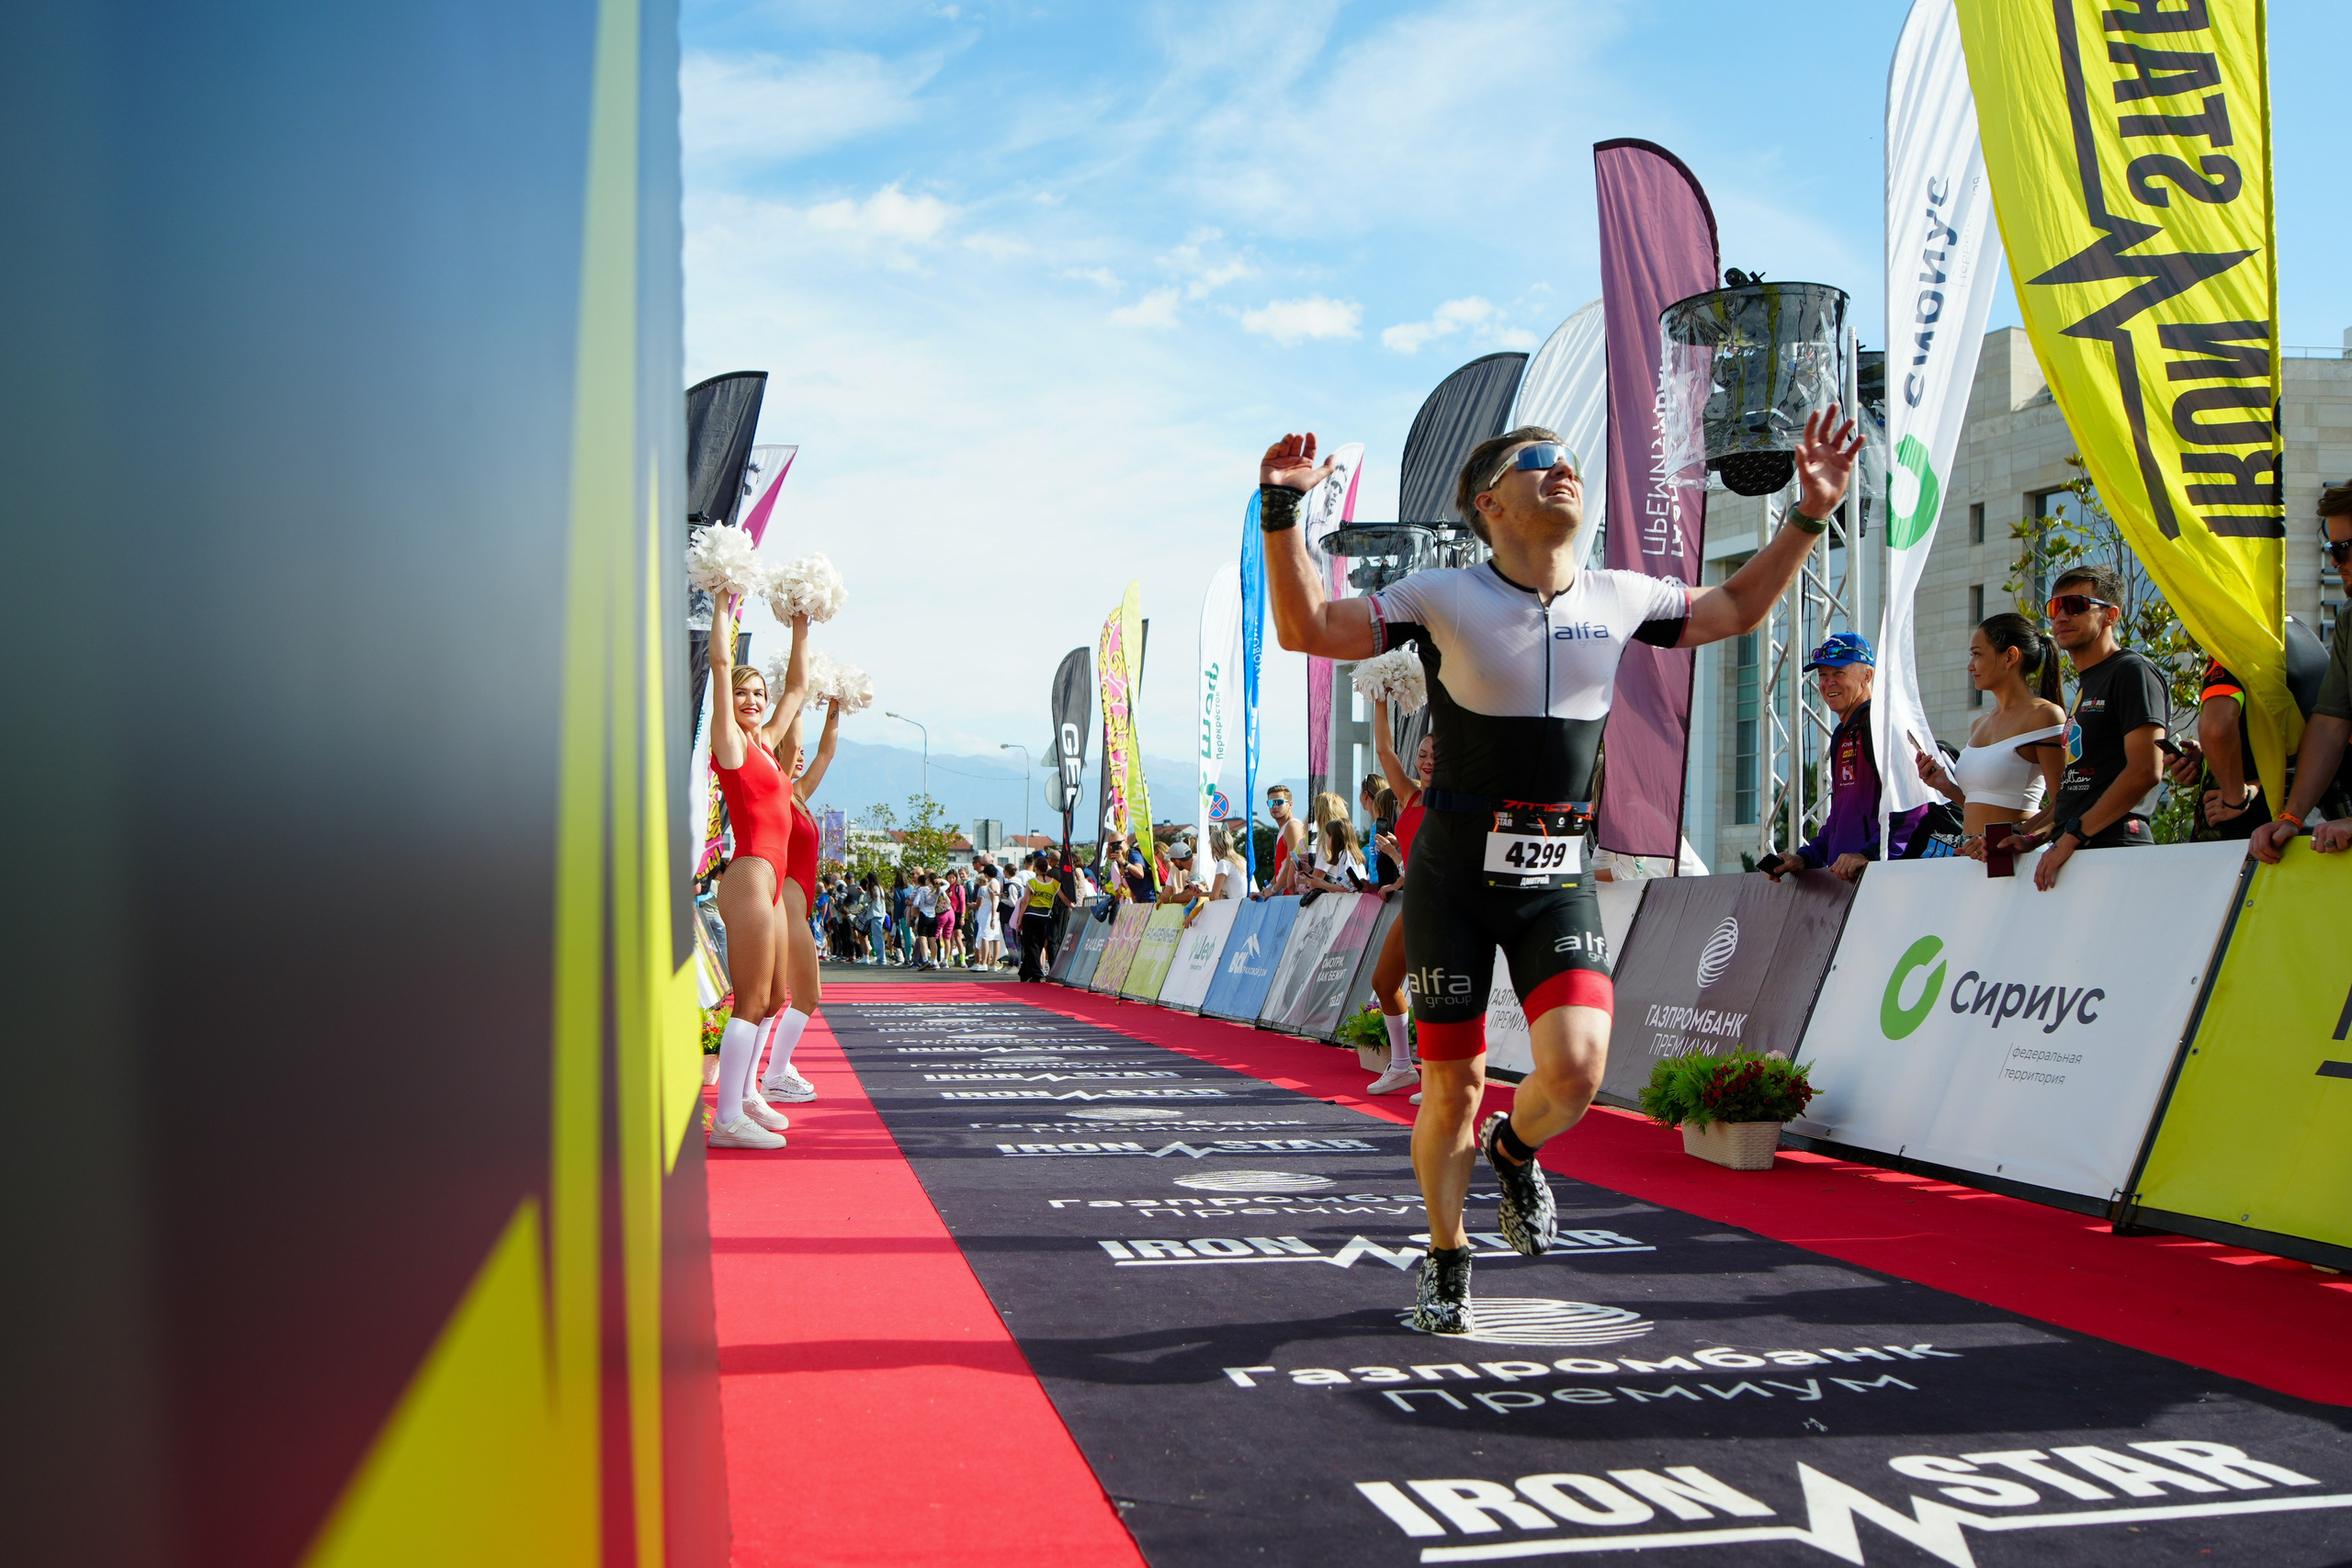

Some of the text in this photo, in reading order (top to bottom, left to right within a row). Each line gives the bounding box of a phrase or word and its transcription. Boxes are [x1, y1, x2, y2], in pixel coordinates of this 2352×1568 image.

[1555, 621, 1609, 640] alfa
[1505, 841, 1566, 868] 4299
[1520, 874, 1550, 886] ДМИТРИЙ
[1555, 931, 1610, 958] alf
[1408, 966, 1472, 995] alfa
[1425, 995, 1472, 1008] group
[1951, 970, 2106, 1033] Сириус
[1489, 1010, 1530, 1032] ПРЕМИУ
[1645, 1004, 1748, 1038] ГАЗПРОМБАНК
[1648, 1032, 1719, 1059] ПРЕМИУМ
[2012, 1045, 2083, 1065] федеральная
[2005, 1067, 2066, 1086] территория
[996, 1139, 1374, 1153] IRON STAR
[1047, 1192, 1505, 1208] Газпромбак
[1139, 1206, 1467, 1218] Премиу
[1098, 1235, 1319, 1259] IRON
[1222, 1343, 1964, 1387] Газпромбанк
[1383, 1374, 1919, 1414] Премиум
[1355, 1438, 2321, 1538] IRON STAR
